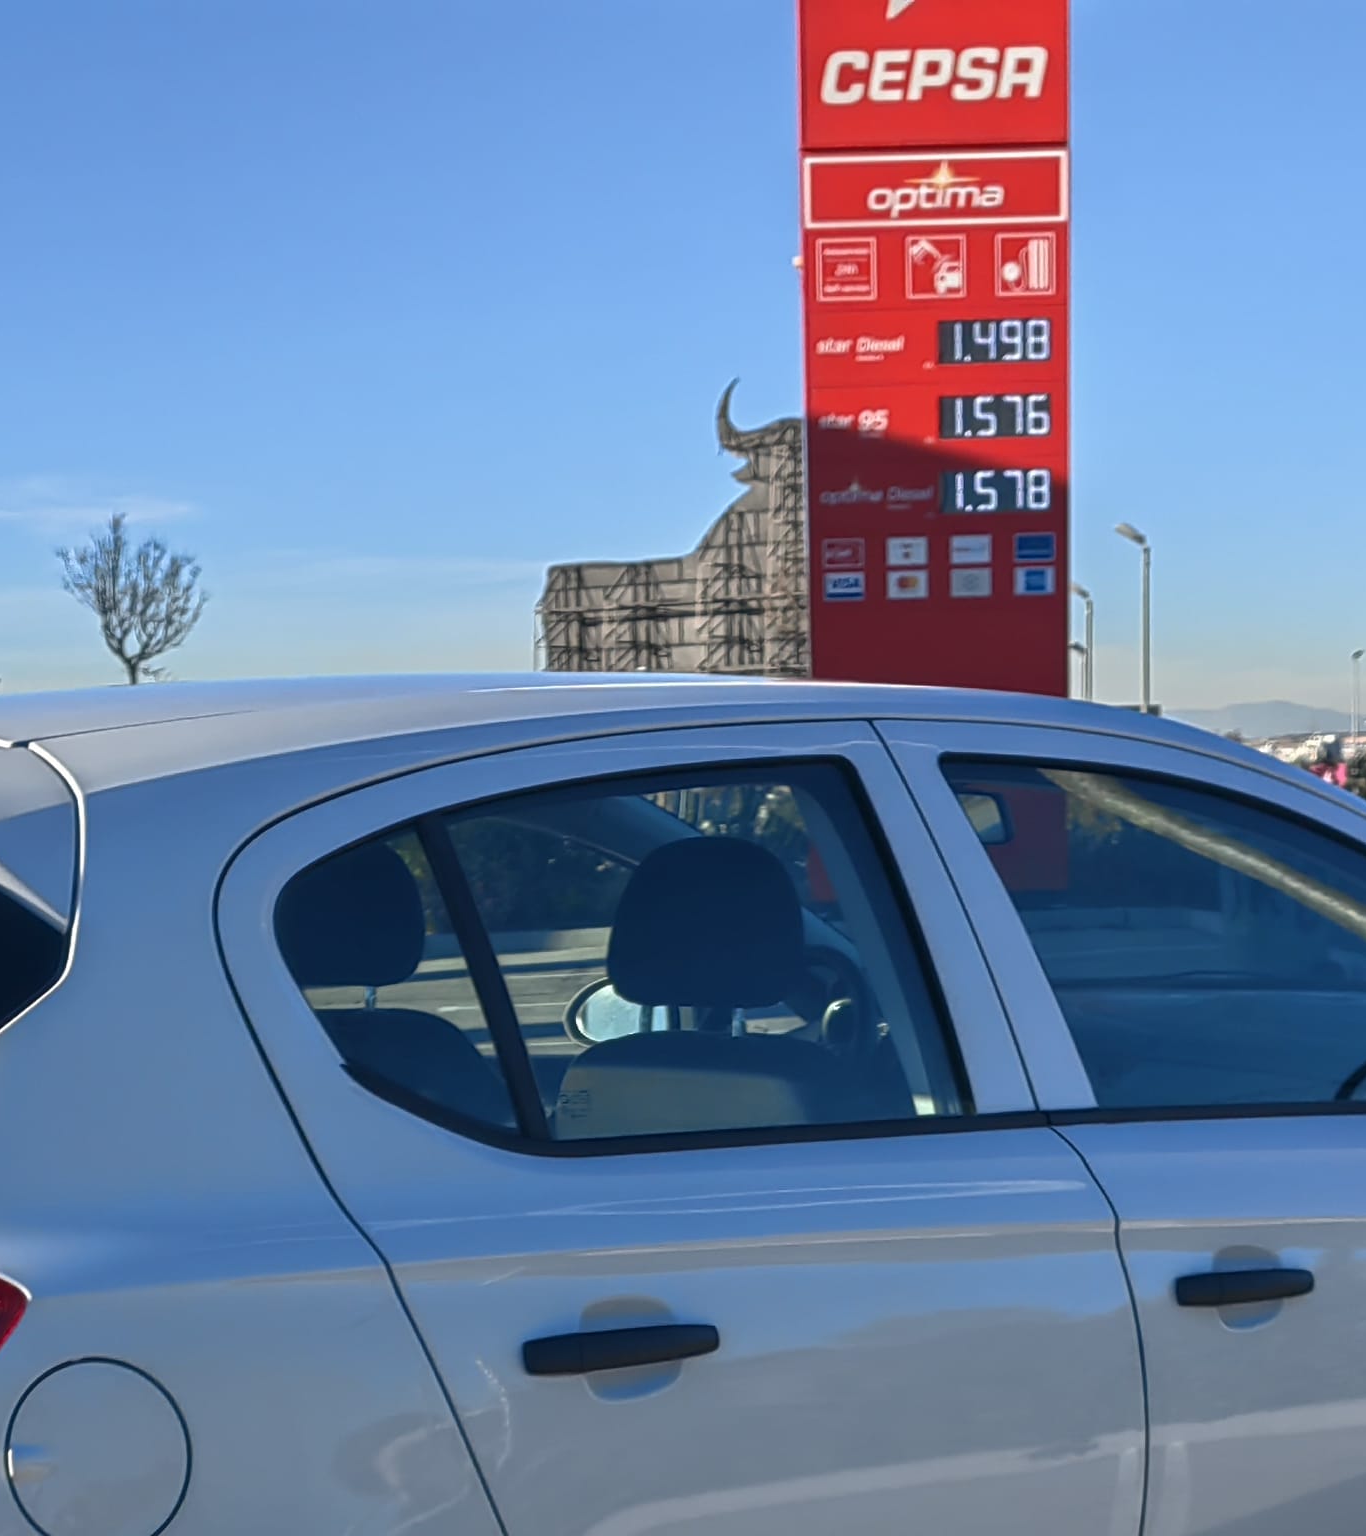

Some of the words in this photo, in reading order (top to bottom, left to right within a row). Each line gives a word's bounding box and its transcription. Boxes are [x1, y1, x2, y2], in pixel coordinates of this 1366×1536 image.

[821, 46, 1048, 104] CEPSA
[867, 183, 1004, 218] optima
[856, 334, 904, 353] Diesel
[954, 318, 1050, 362] 1.498
[858, 409, 889, 432] 95
[954, 393, 1050, 437] 1.576
[954, 469, 1050, 512] 1.578
